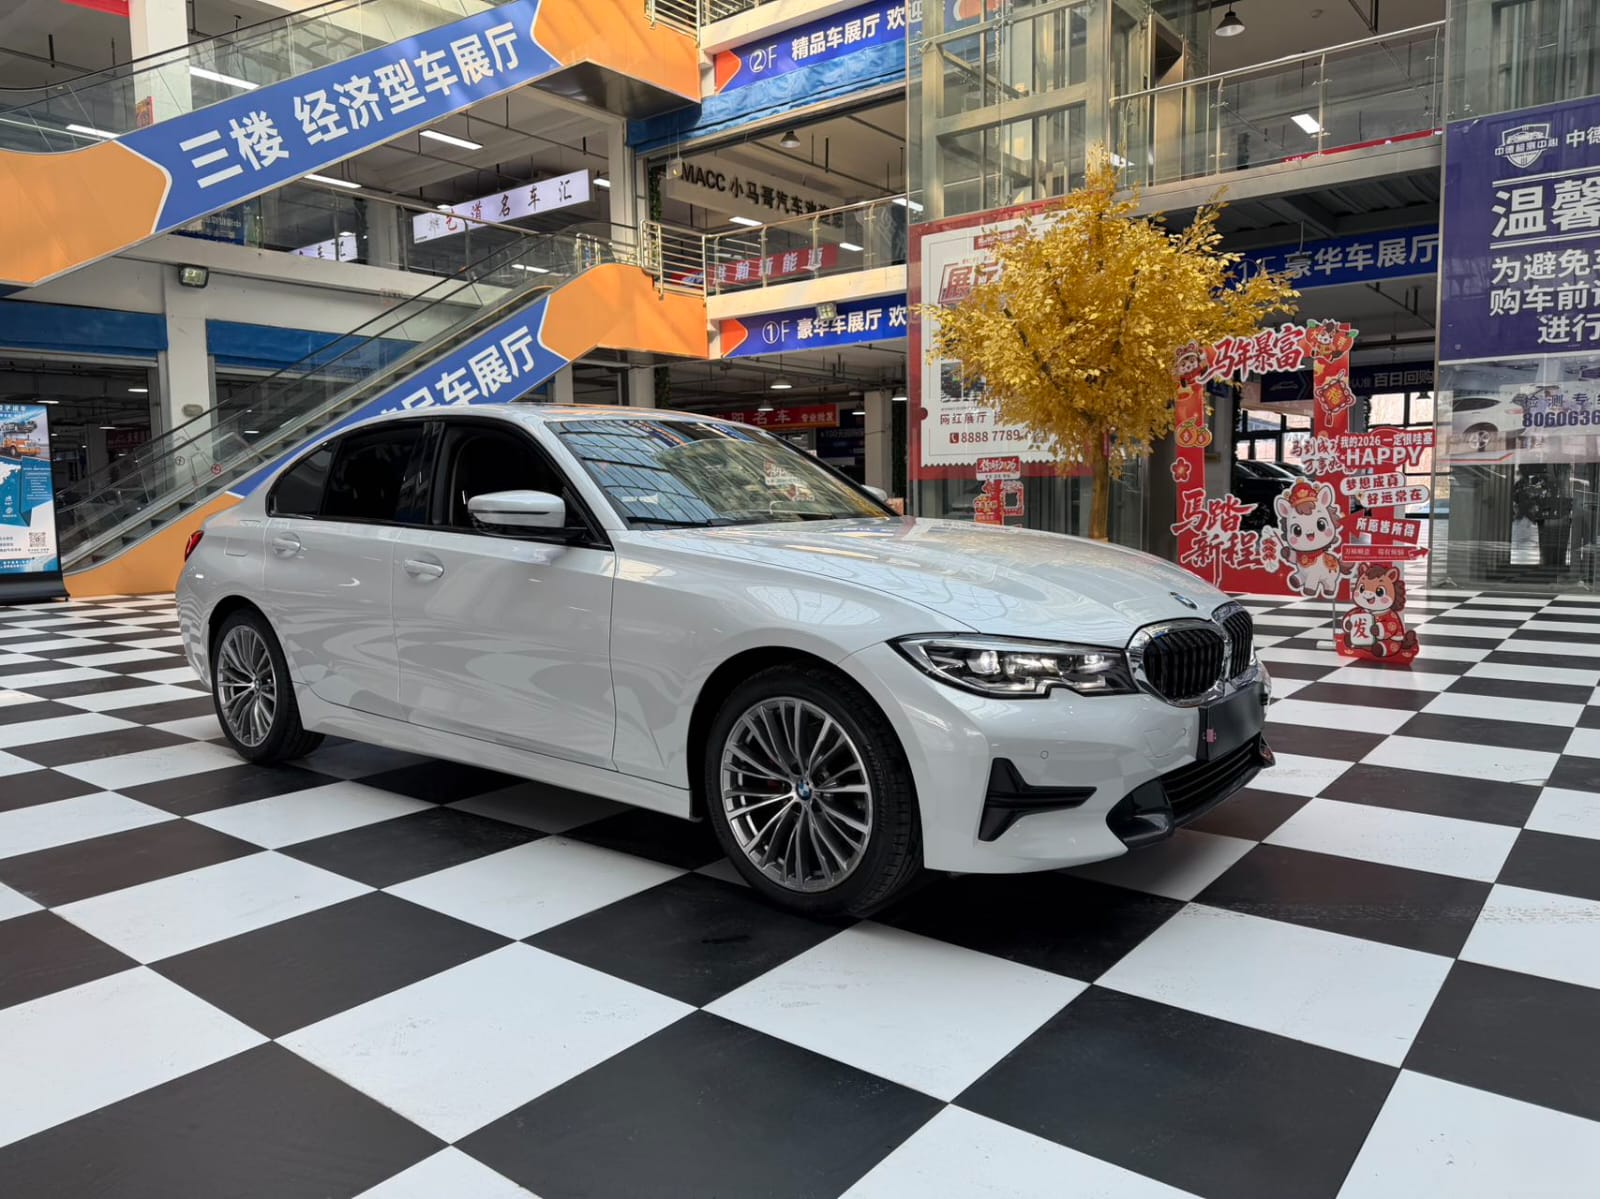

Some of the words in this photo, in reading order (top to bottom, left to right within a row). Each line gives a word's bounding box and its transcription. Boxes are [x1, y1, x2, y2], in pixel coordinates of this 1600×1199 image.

[791, 13, 881, 61] 精品车展厅
[180, 110, 289, 188] 三楼
[294, 22, 520, 145] 经济型车展厅
[1491, 178, 1600, 238] 温馨
[1283, 233, 1439, 280] 豪华车展厅
[1491, 248, 1600, 284] 为避免
[1489, 280, 1600, 316] 购车前
[797, 308, 882, 340] 豪华车展厅
[1537, 313, 1600, 343] 进行
[1201, 325, 1304, 382] 马年暴富
[961, 432, 989, 443] 8888
[992, 429, 1020, 441] 7789
[1346, 446, 1422, 466] HAPPY
[1346, 474, 1400, 491] 梦想成真
[1366, 489, 1423, 506] 好运常在
[1170, 488, 1258, 535] 马踏
[1356, 517, 1416, 537] 所愿皆所得
[1353, 617, 1370, 638] 发
